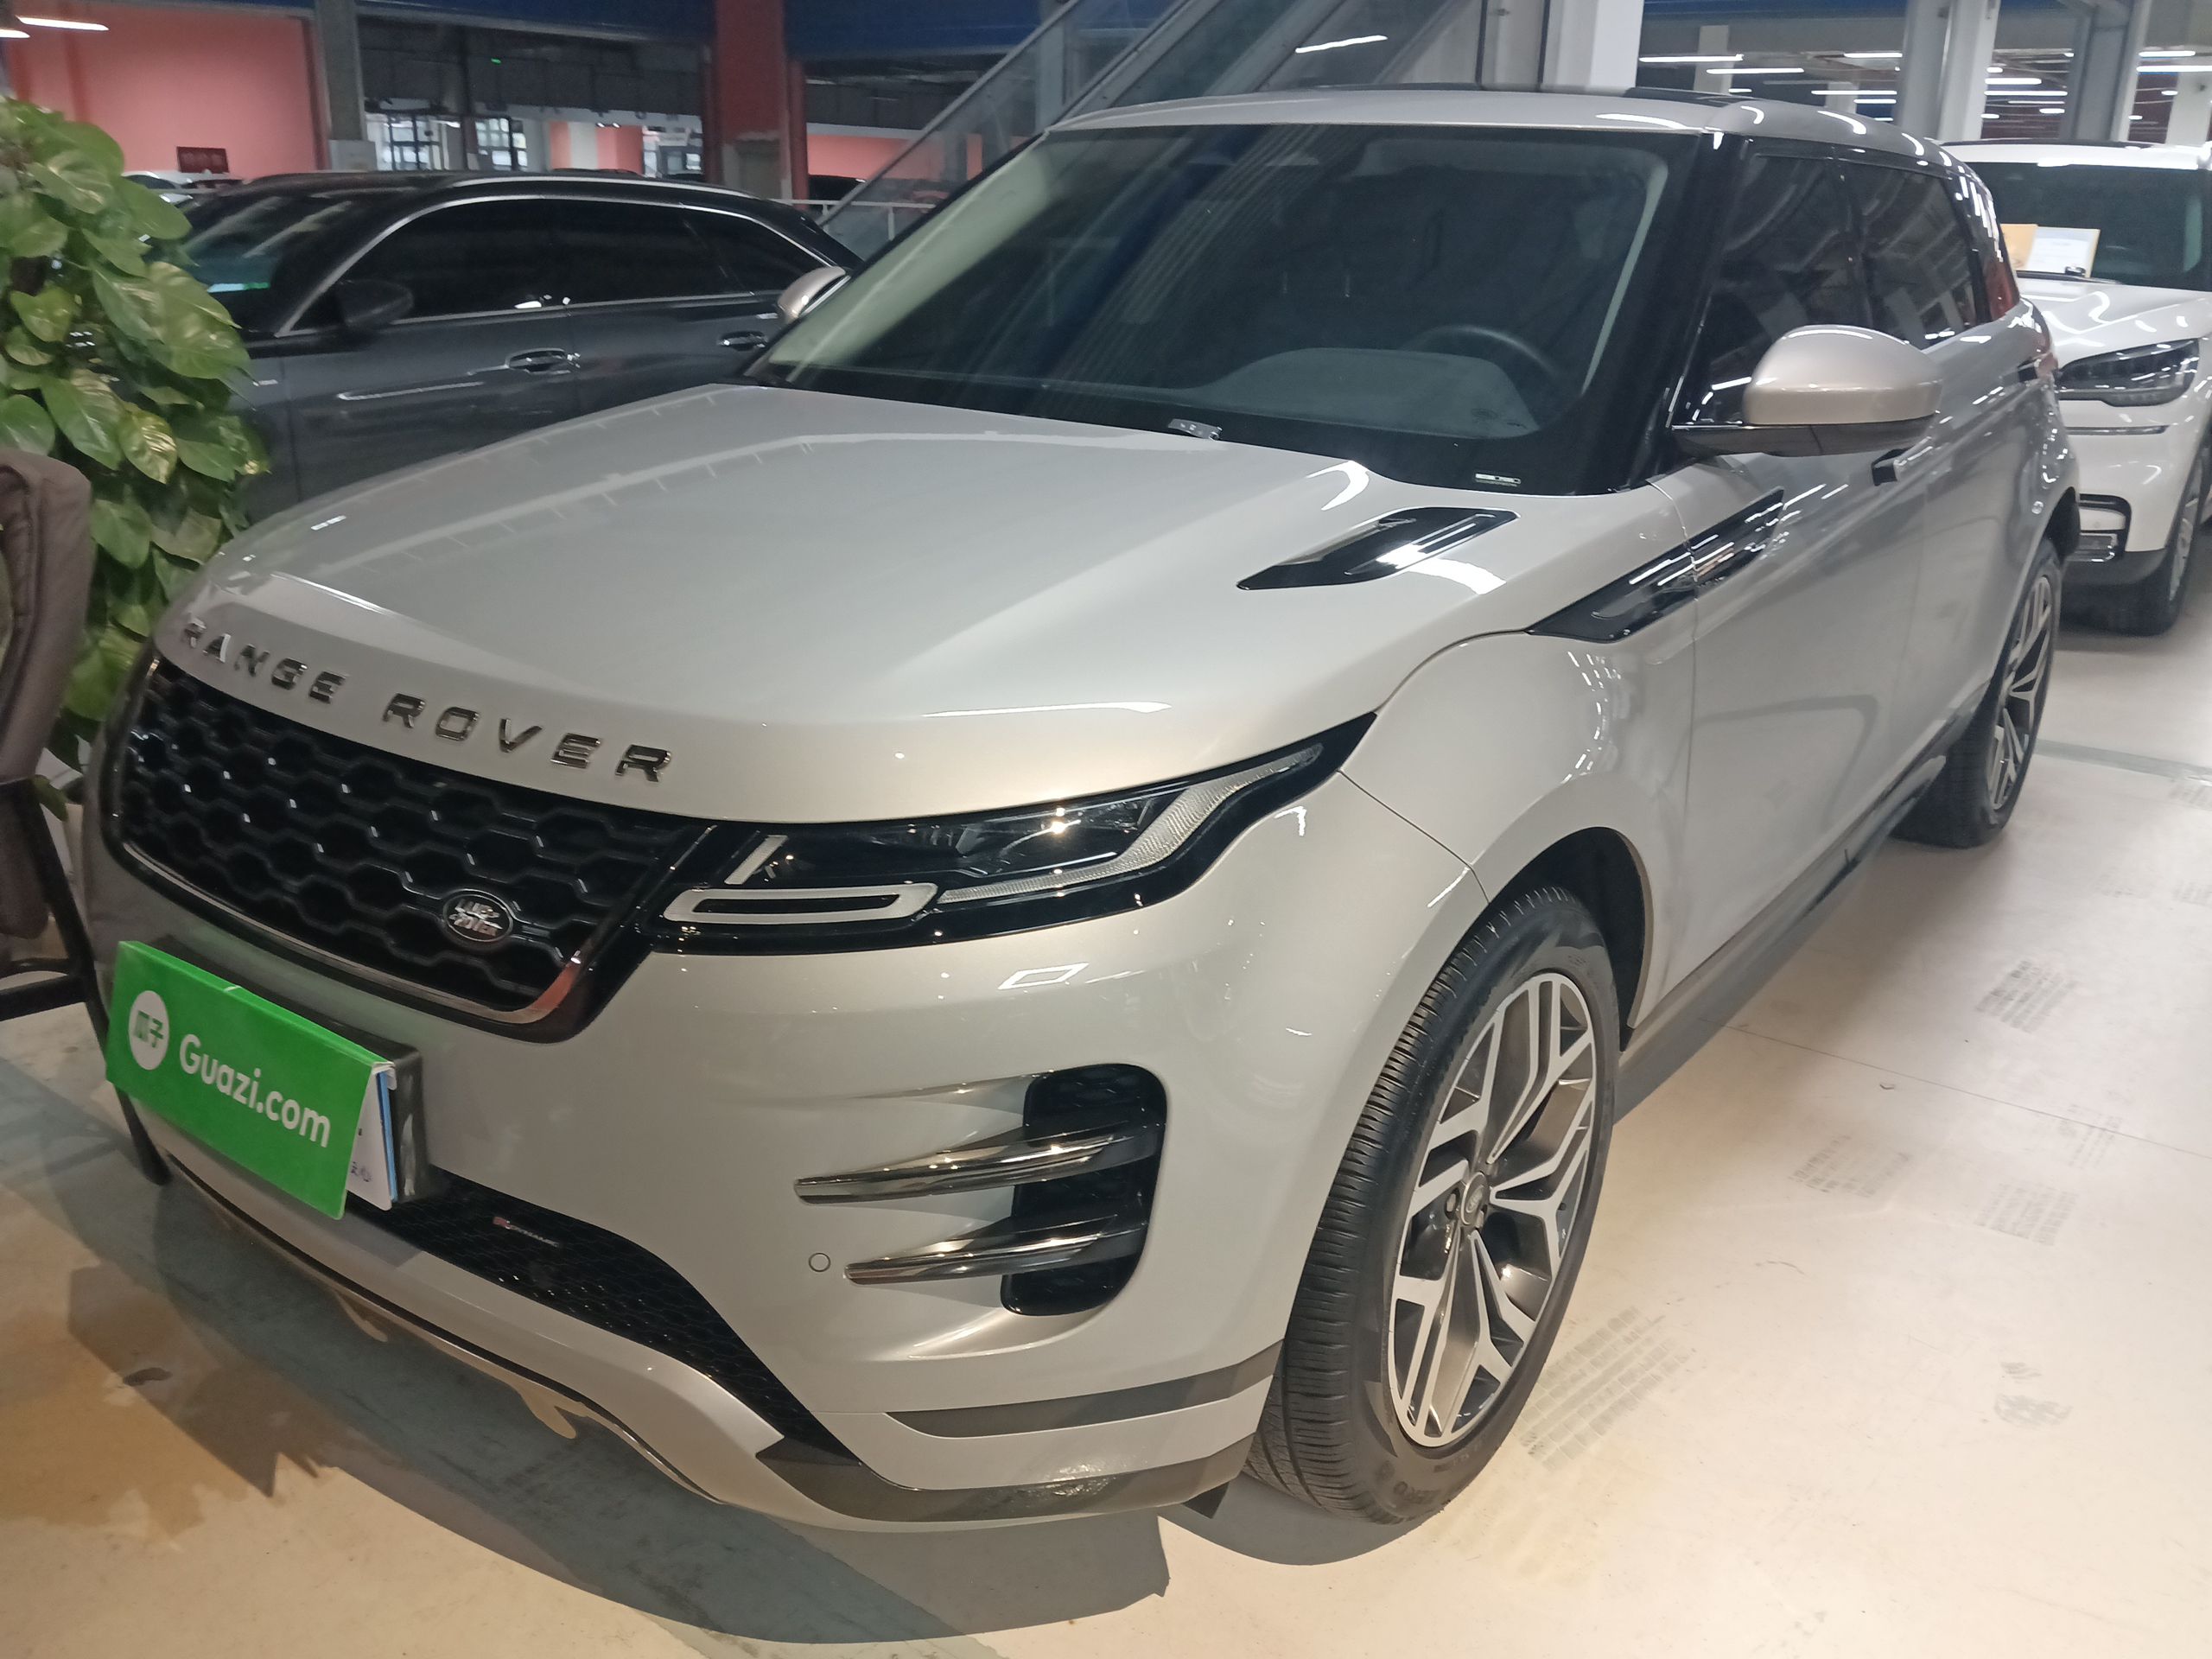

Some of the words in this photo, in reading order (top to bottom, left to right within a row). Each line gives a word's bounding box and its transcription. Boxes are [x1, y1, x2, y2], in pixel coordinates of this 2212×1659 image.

[181, 614, 348, 704] RANGE
[383, 692, 672, 782] ROVER
[179, 1033, 332, 1148] Guazi.com
